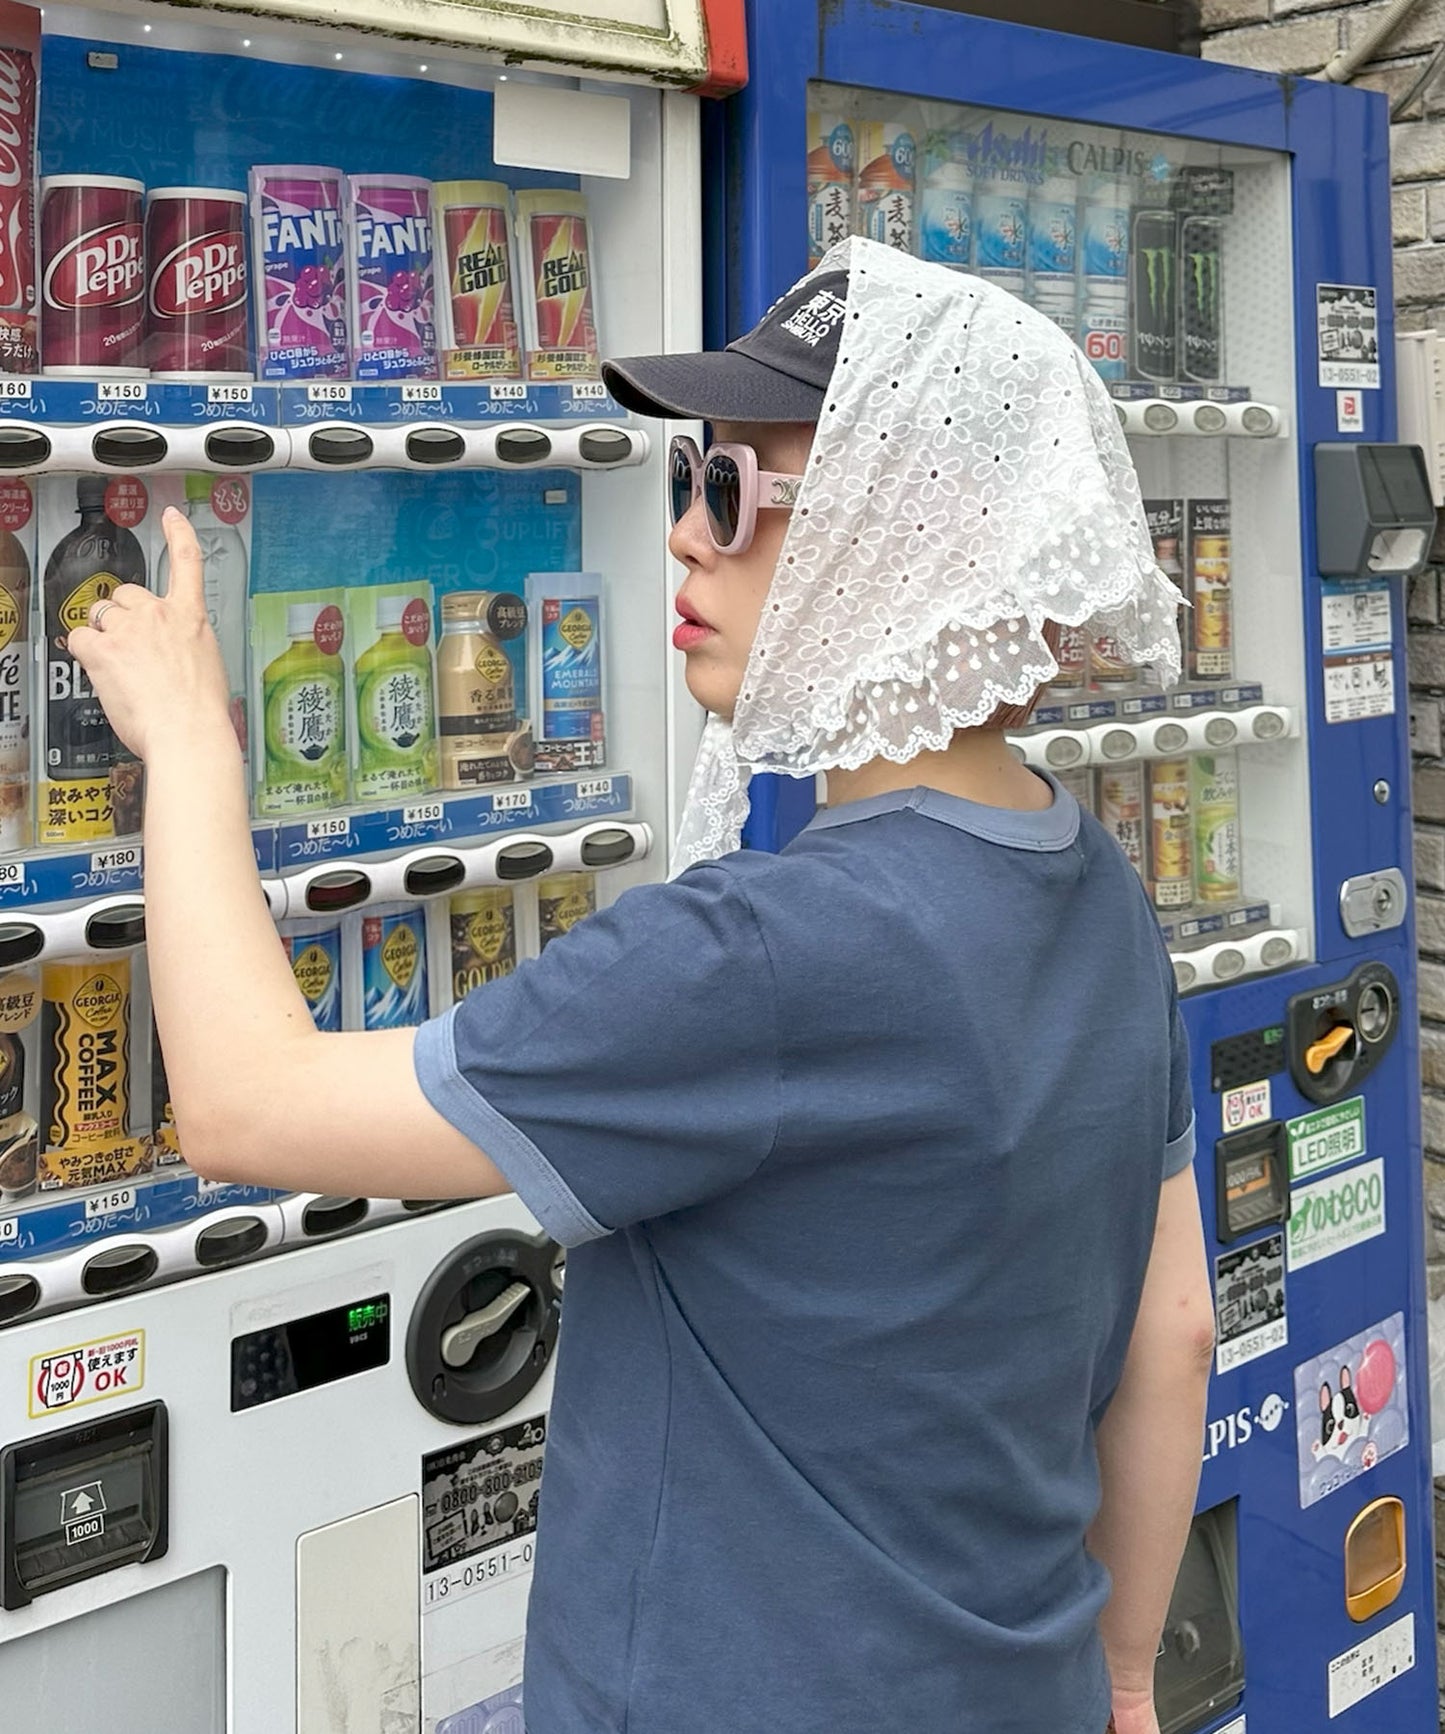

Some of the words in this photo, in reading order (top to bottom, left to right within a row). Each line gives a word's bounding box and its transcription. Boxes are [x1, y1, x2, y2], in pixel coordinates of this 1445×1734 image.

[1066, 140, 1145, 177] CALPIS
[106, 233, 139, 259] Dr
[204, 242, 238, 268] Dr
[458, 243, 505, 272] REAL
[544, 250, 587, 279] REAL
[460, 263, 507, 294] GOLD
[545, 270, 588, 297] GOLD
[800, 289, 847, 326] 東京
[780, 319, 820, 348] SHIBUYA
[789, 308, 830, 338] HELLO
[102, 385, 142, 398] ¥150
[212, 388, 249, 400] ¥150
[312, 387, 347, 399] ¥150
[406, 387, 438, 399] ¥150
[493, 386, 524, 397] ¥140
[575, 384, 605, 396] ¥140
[297, 684, 326, 744] 綾鷹
[388, 673, 416, 732] 綾鷹
[48, 783, 126, 806] 飲みやすく
[580, 782, 609, 794] ¥140
[496, 794, 527, 807] ¥170
[48, 804, 115, 826] 深いコク
[406, 805, 441, 821] ¥150
[311, 821, 347, 836] ¥150
[98, 850, 135, 868] ¥180
[75, 992, 122, 1008] GEORGIA
[85, 1006, 113, 1019] Coffee
[77, 1033, 95, 1112] COFFEE
[96, 1029, 118, 1109] MAX
[59, 1145, 135, 1168] やみつきの甘さ
[1296, 1125, 1357, 1168] LED照明
[67, 1160, 127, 1182] 元気MAX
[89, 1190, 130, 1212] ¥150
[87, 1348, 138, 1372] 使えます
[50, 1380, 70, 1392] 1000
[95, 1365, 128, 1391] OK
[71, 1521, 99, 1539] 1000
